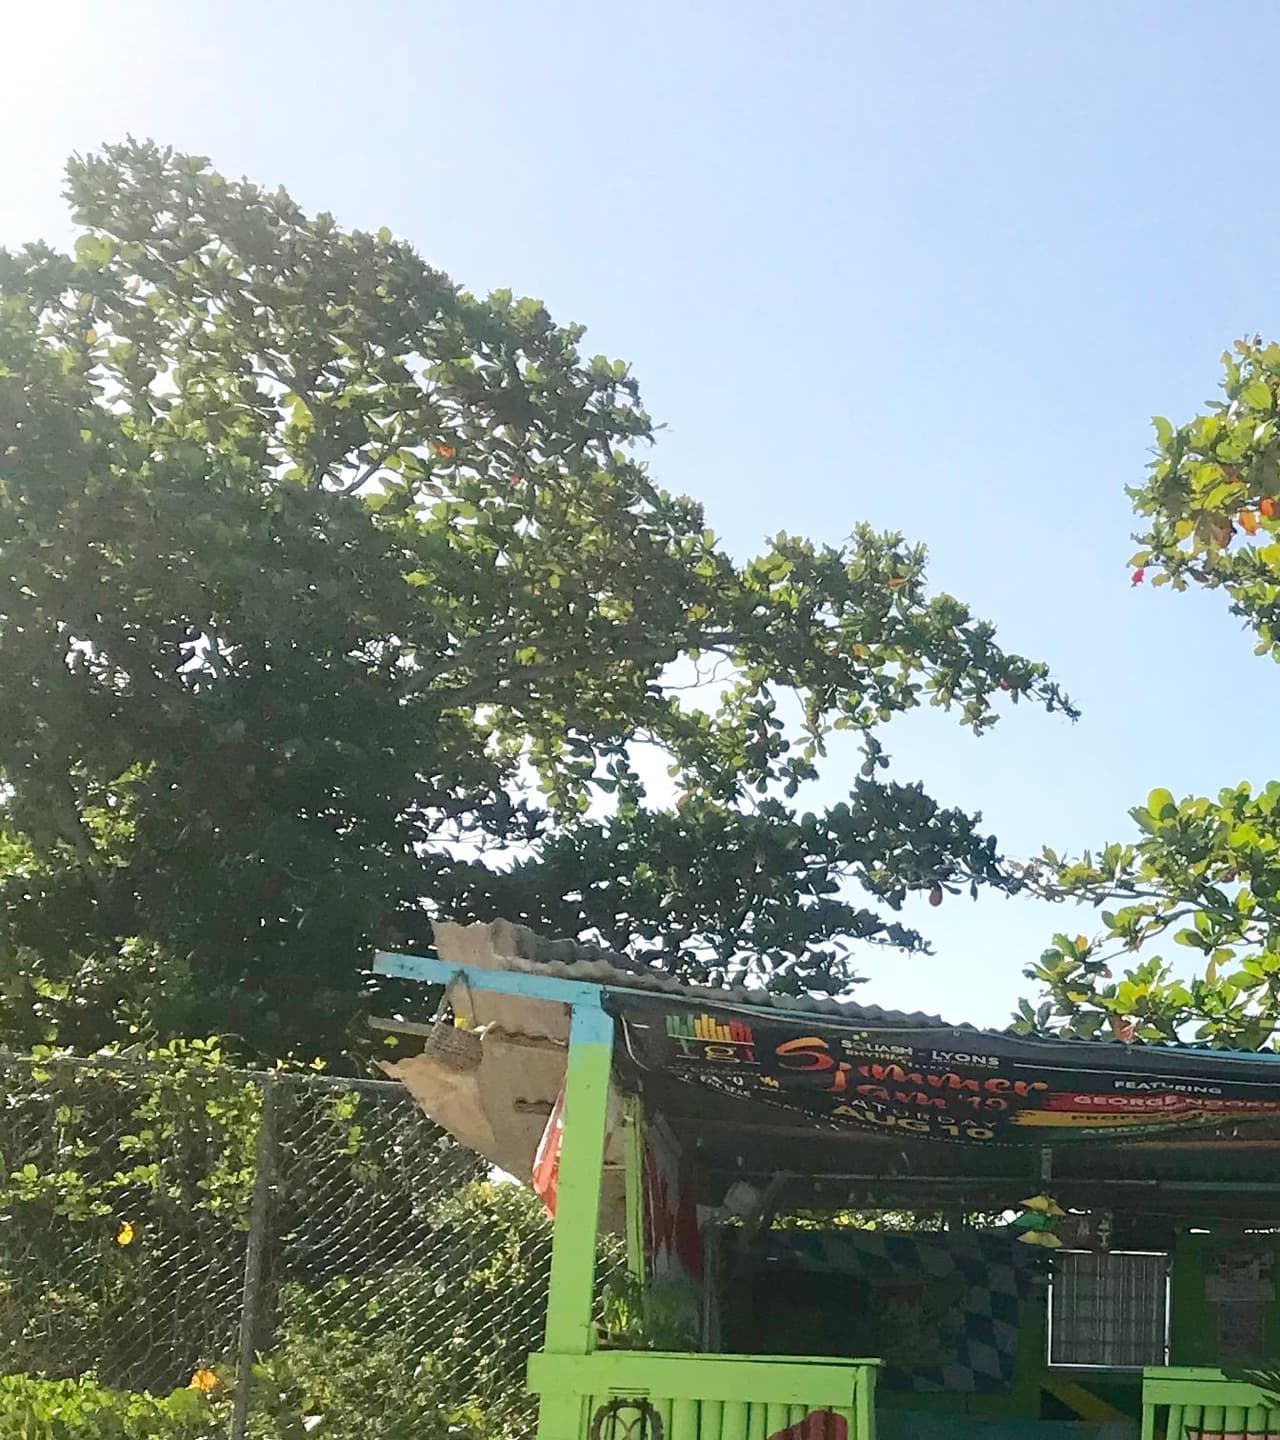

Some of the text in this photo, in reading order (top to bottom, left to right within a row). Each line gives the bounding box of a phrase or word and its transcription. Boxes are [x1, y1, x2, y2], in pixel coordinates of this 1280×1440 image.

[932, 1051, 1000, 1066] LYONS
[1113, 1080, 1223, 1096] FEATURING
[833, 1104, 930, 1133] AUG
[940, 1123, 995, 1141] 10
